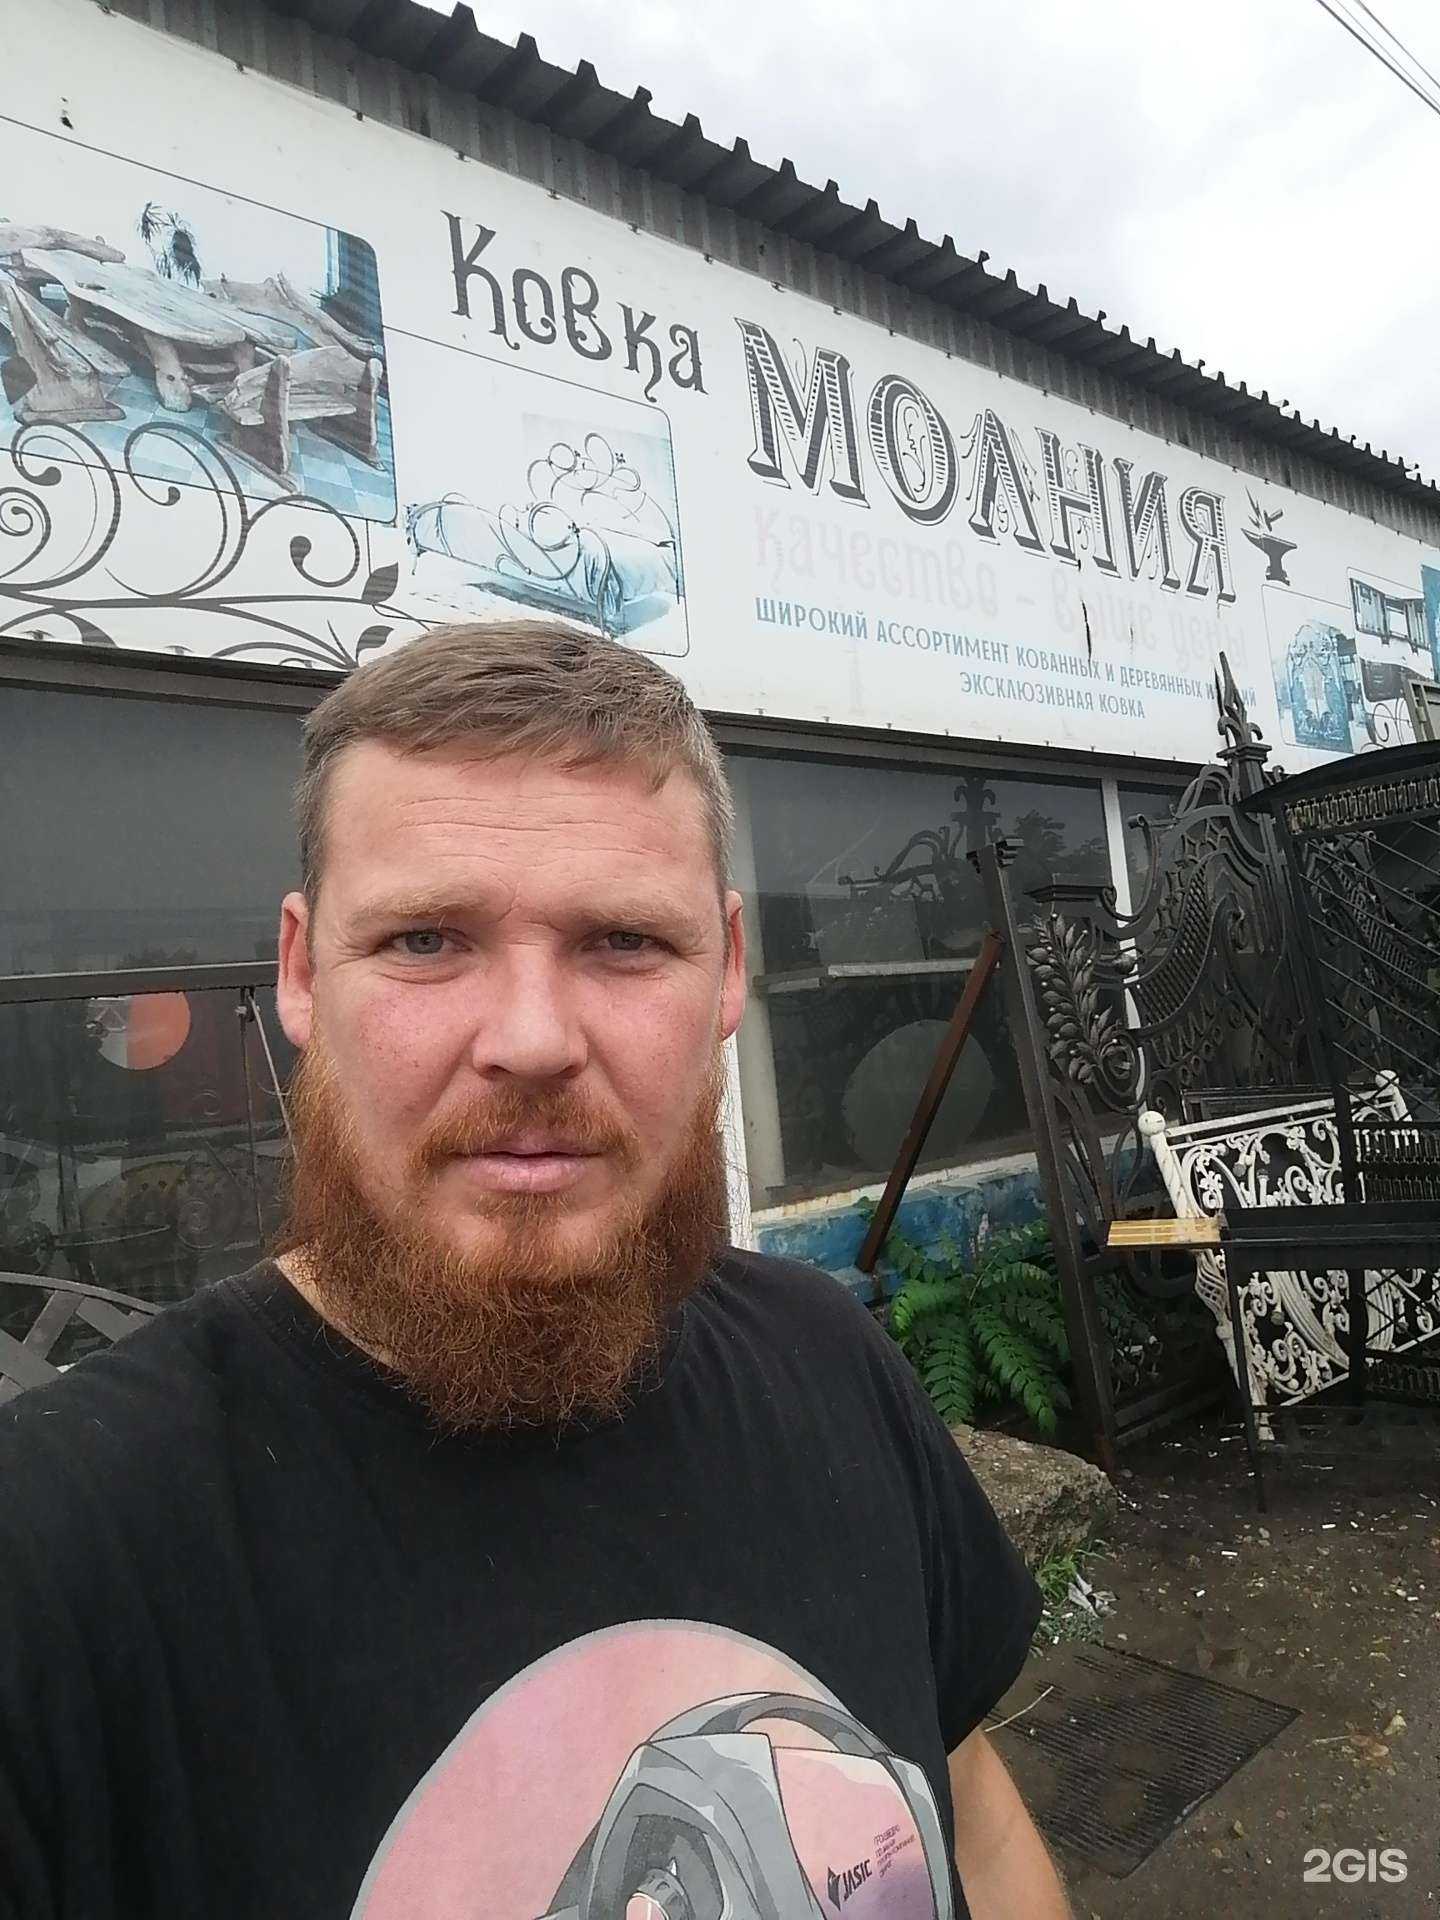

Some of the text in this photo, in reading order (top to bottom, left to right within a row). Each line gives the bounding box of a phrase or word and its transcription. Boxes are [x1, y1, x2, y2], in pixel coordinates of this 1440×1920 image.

[440, 210, 709, 403] Ковка
[734, 317, 1239, 606] МОЛНИЯ
[755, 597, 868, 640] ШИРОКИЙ
[877, 620, 1009, 664] АССОРТИМЕНТ
[1016, 646, 1101, 680] КОВАННЫХ
[1104, 662, 1115, 683] И
[1120, 666, 1202, 699] ДЕРЕВЯННЫХ
[959, 671, 1146, 720] ЭКСКЛЮЗИВНАЯ КОВКА
[843, 1858, 873, 1902] JASIC
